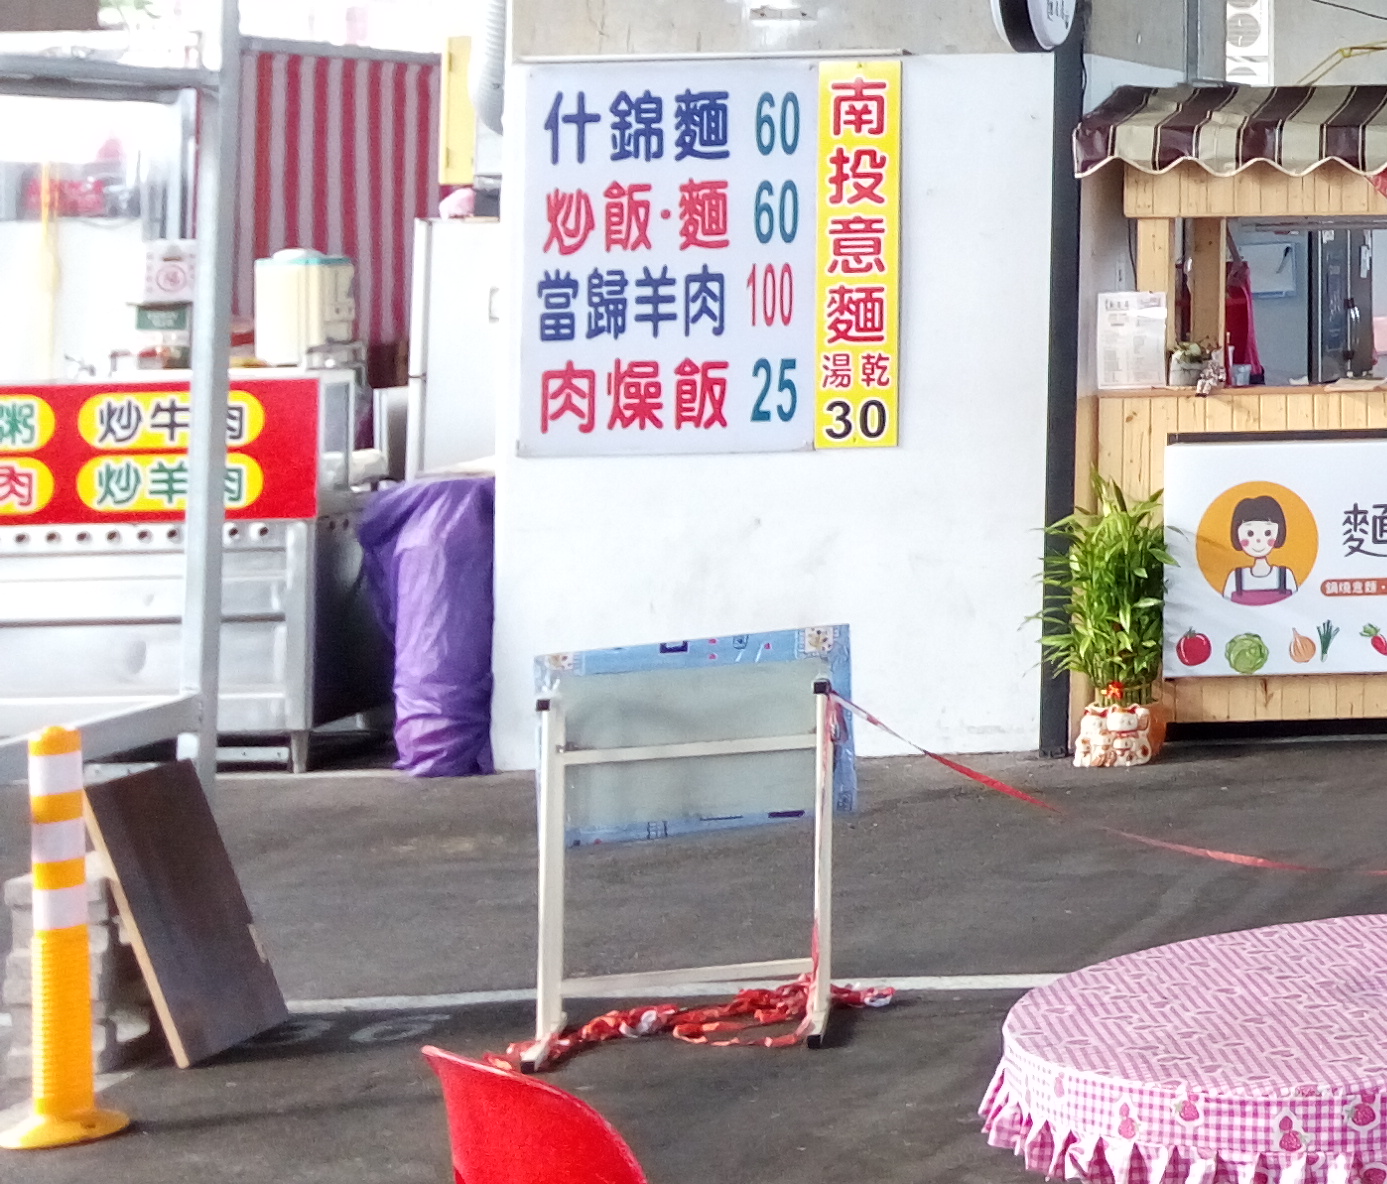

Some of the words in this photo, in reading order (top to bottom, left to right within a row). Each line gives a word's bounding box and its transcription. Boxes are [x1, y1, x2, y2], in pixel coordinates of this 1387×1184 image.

[544, 89, 730, 165] 什錦麵
[755, 91, 800, 156] 60
[754, 180, 798, 244] 60
[828, 78, 886, 344] 南投意麵
[538, 264, 725, 341] 當歸羊肉
[747, 263, 793, 326] 100
[541, 357, 729, 433] 肉燥飯
[750, 358, 797, 422] 25
[825, 399, 886, 440] 30
